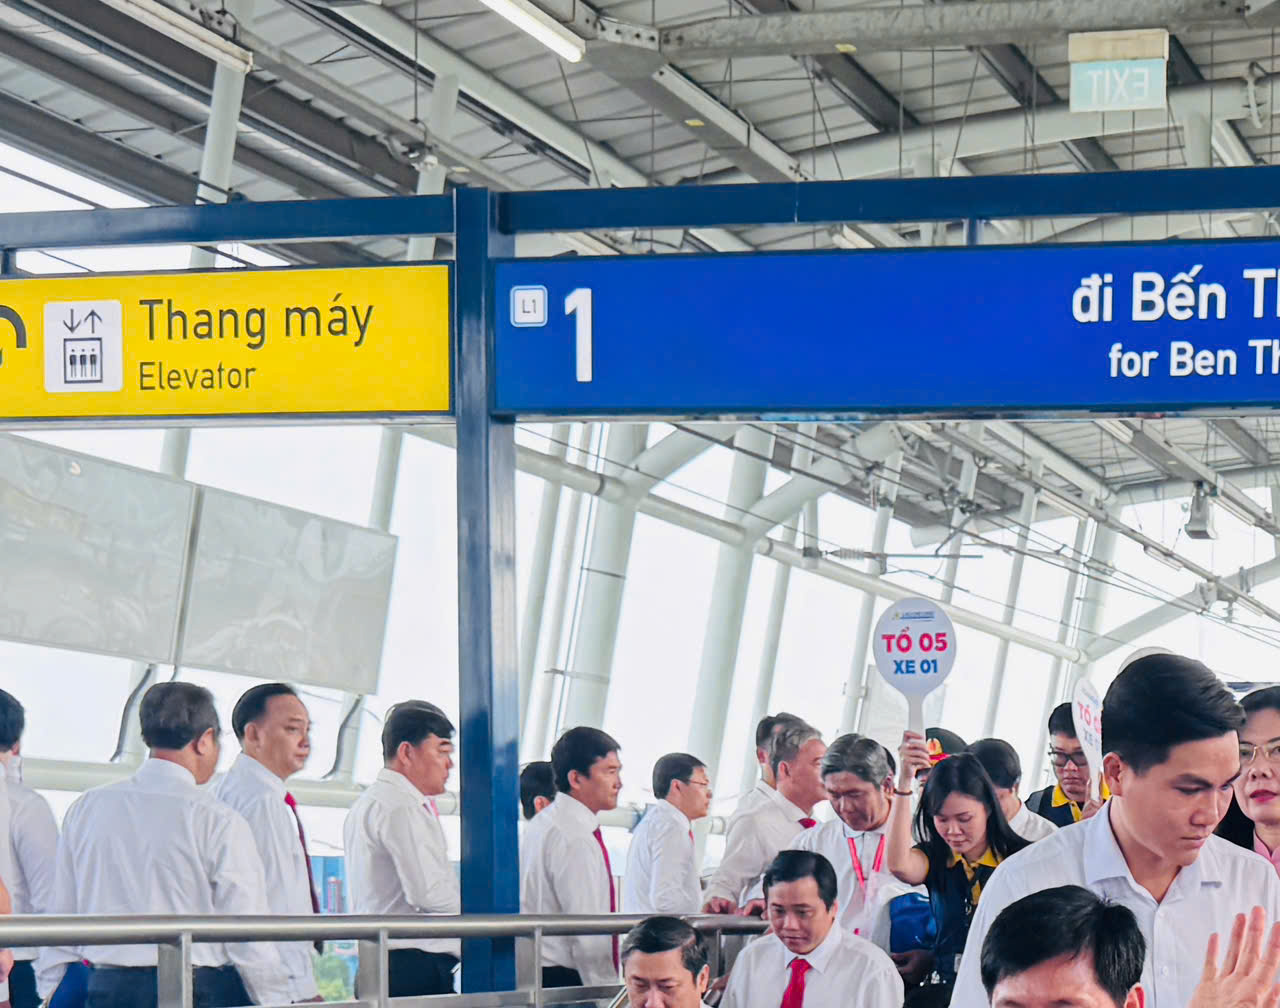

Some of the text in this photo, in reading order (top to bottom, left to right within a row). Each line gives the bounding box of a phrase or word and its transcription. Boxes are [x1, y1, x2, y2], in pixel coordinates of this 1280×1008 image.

[522, 299, 537, 314] L1
[1072, 273, 1113, 323] đi
[1132, 264, 1227, 321] Bến
[139, 292, 374, 350] Thang máy
[563, 287, 593, 382] 1
[139, 360, 257, 391] Elevator
[1108, 342, 1159, 378] for
[1169, 341, 1238, 377] Ben
[919, 632, 949, 652] 05
[893, 659, 938, 675] XE 01
